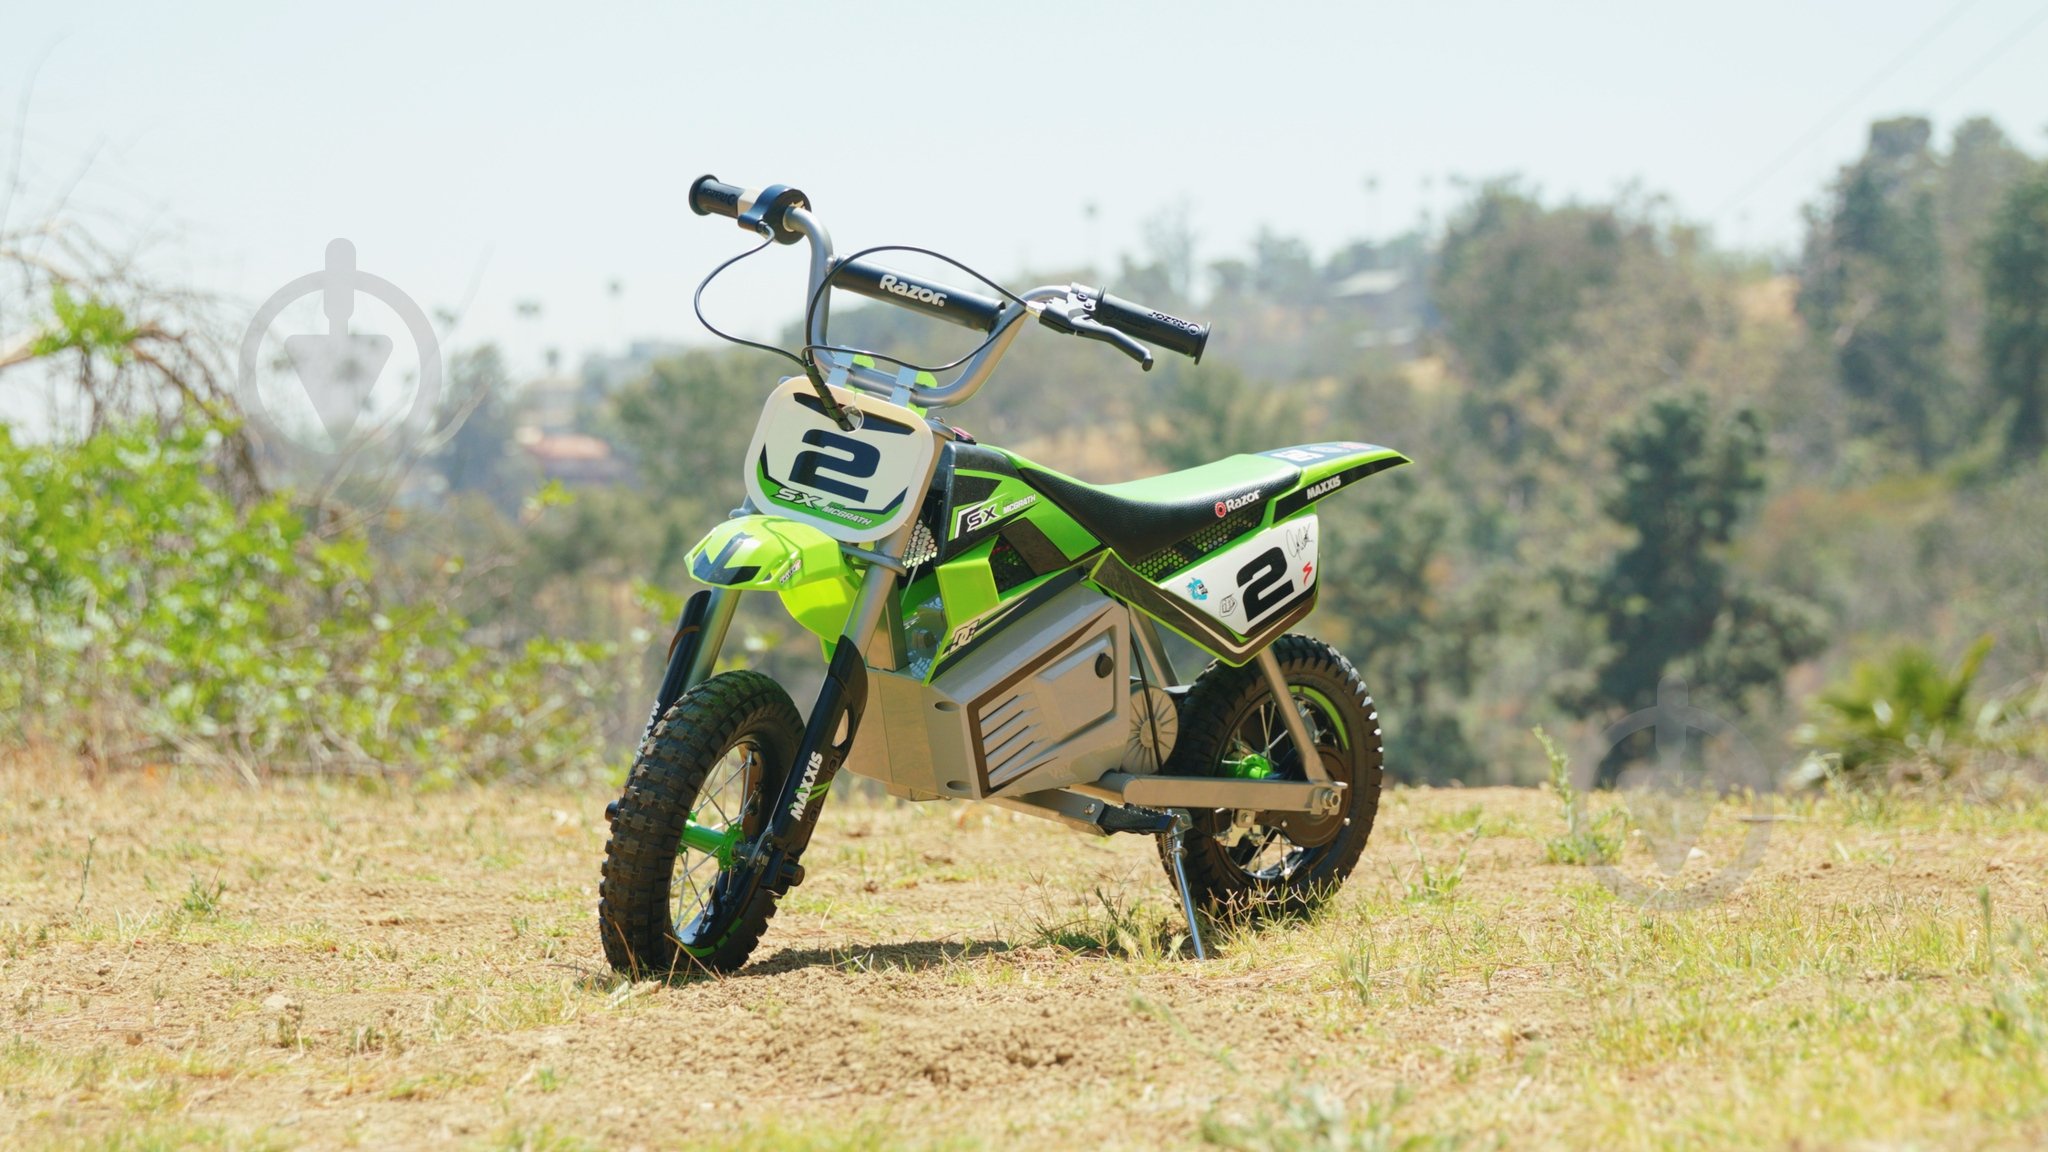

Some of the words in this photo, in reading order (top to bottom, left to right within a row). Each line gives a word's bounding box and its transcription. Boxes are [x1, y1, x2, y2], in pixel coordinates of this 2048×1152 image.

[880, 274, 947, 306] Razor
[788, 428, 881, 504] 2
[774, 487, 821, 509] SX
[821, 505, 873, 526] MCGRATH
[1225, 489, 1260, 513] Razor
[1306, 475, 1341, 500] MAXXIS
[966, 503, 1001, 532] SX
[1003, 494, 1036, 514] MCGRATH
[1236, 546, 1295, 622] 2
[790, 751, 823, 821] MAXXIS
